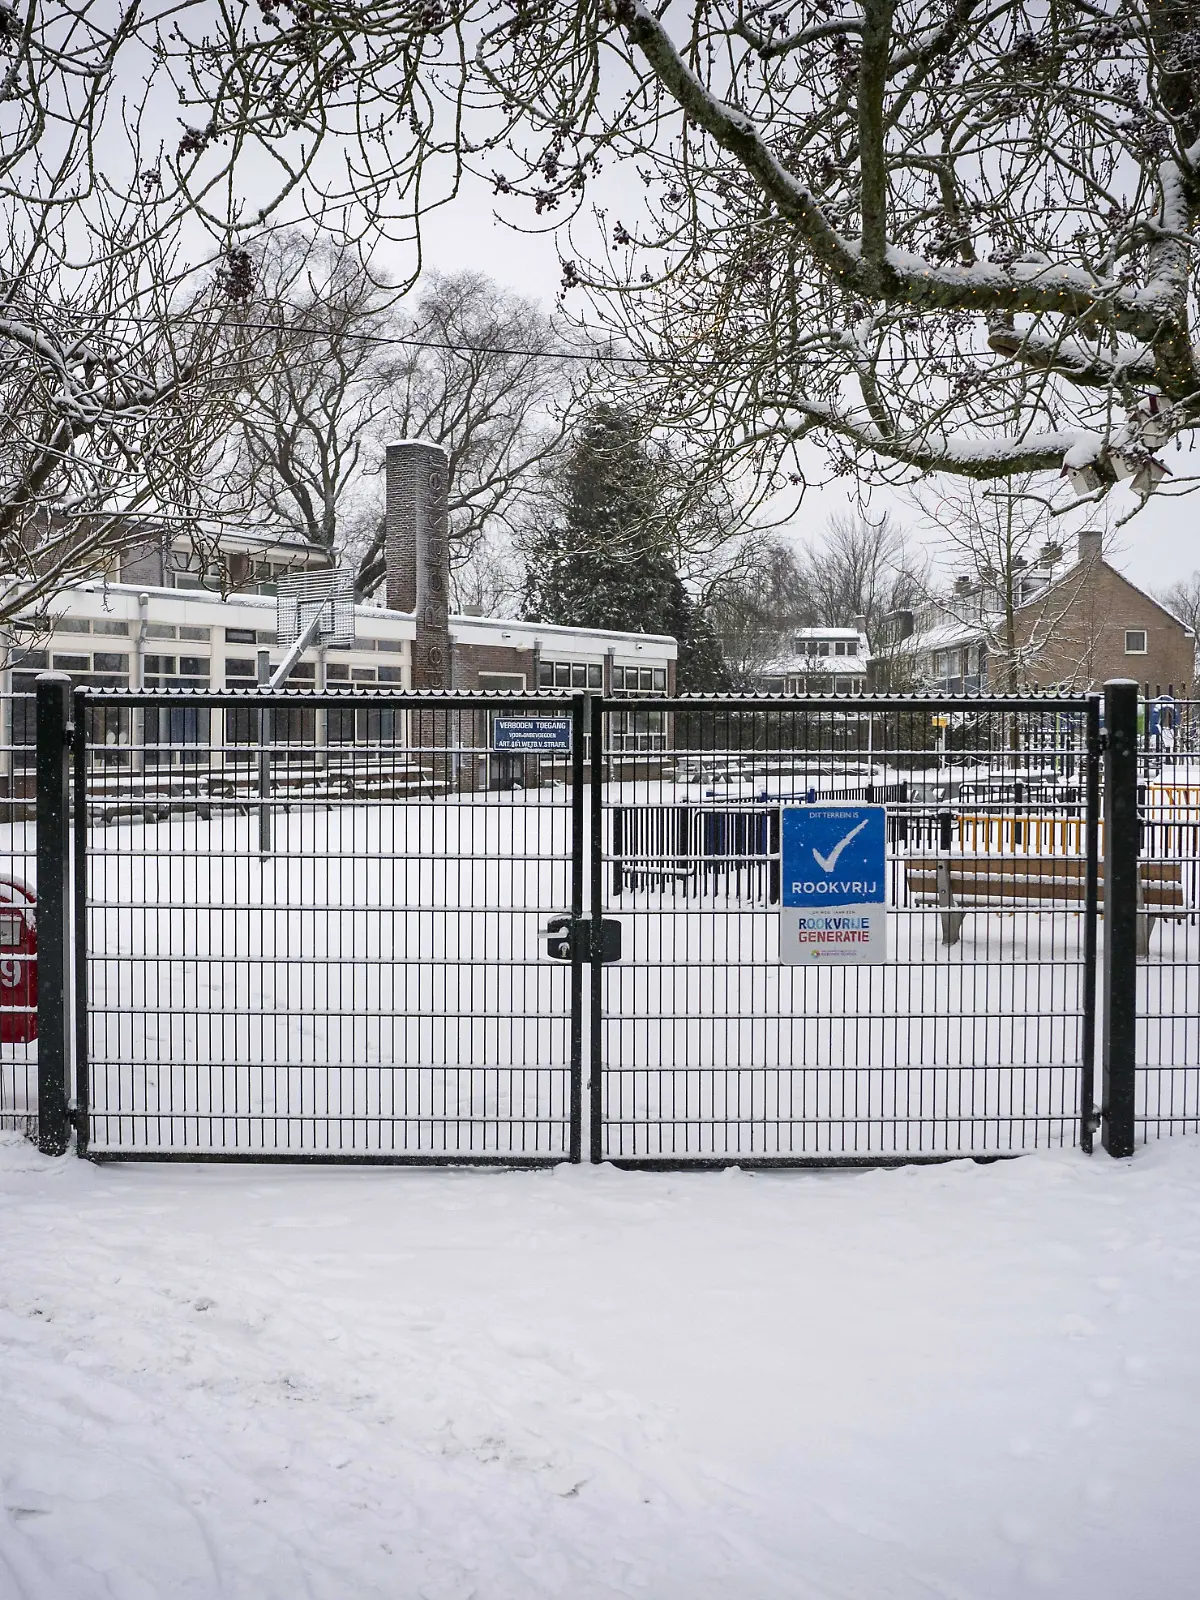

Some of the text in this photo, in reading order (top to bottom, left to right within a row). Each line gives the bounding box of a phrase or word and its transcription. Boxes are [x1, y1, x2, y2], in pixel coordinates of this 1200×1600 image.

[499, 721, 566, 730] VERBODEN TOEGANG
[809, 811, 859, 819] DIT TERREIN IS
[792, 882, 877, 894] ROOKVRIJ
[798, 917, 870, 930] ROOKVRIJE
[798, 931, 870, 943] GENERATIE
[0, 959, 22, 988] 9
